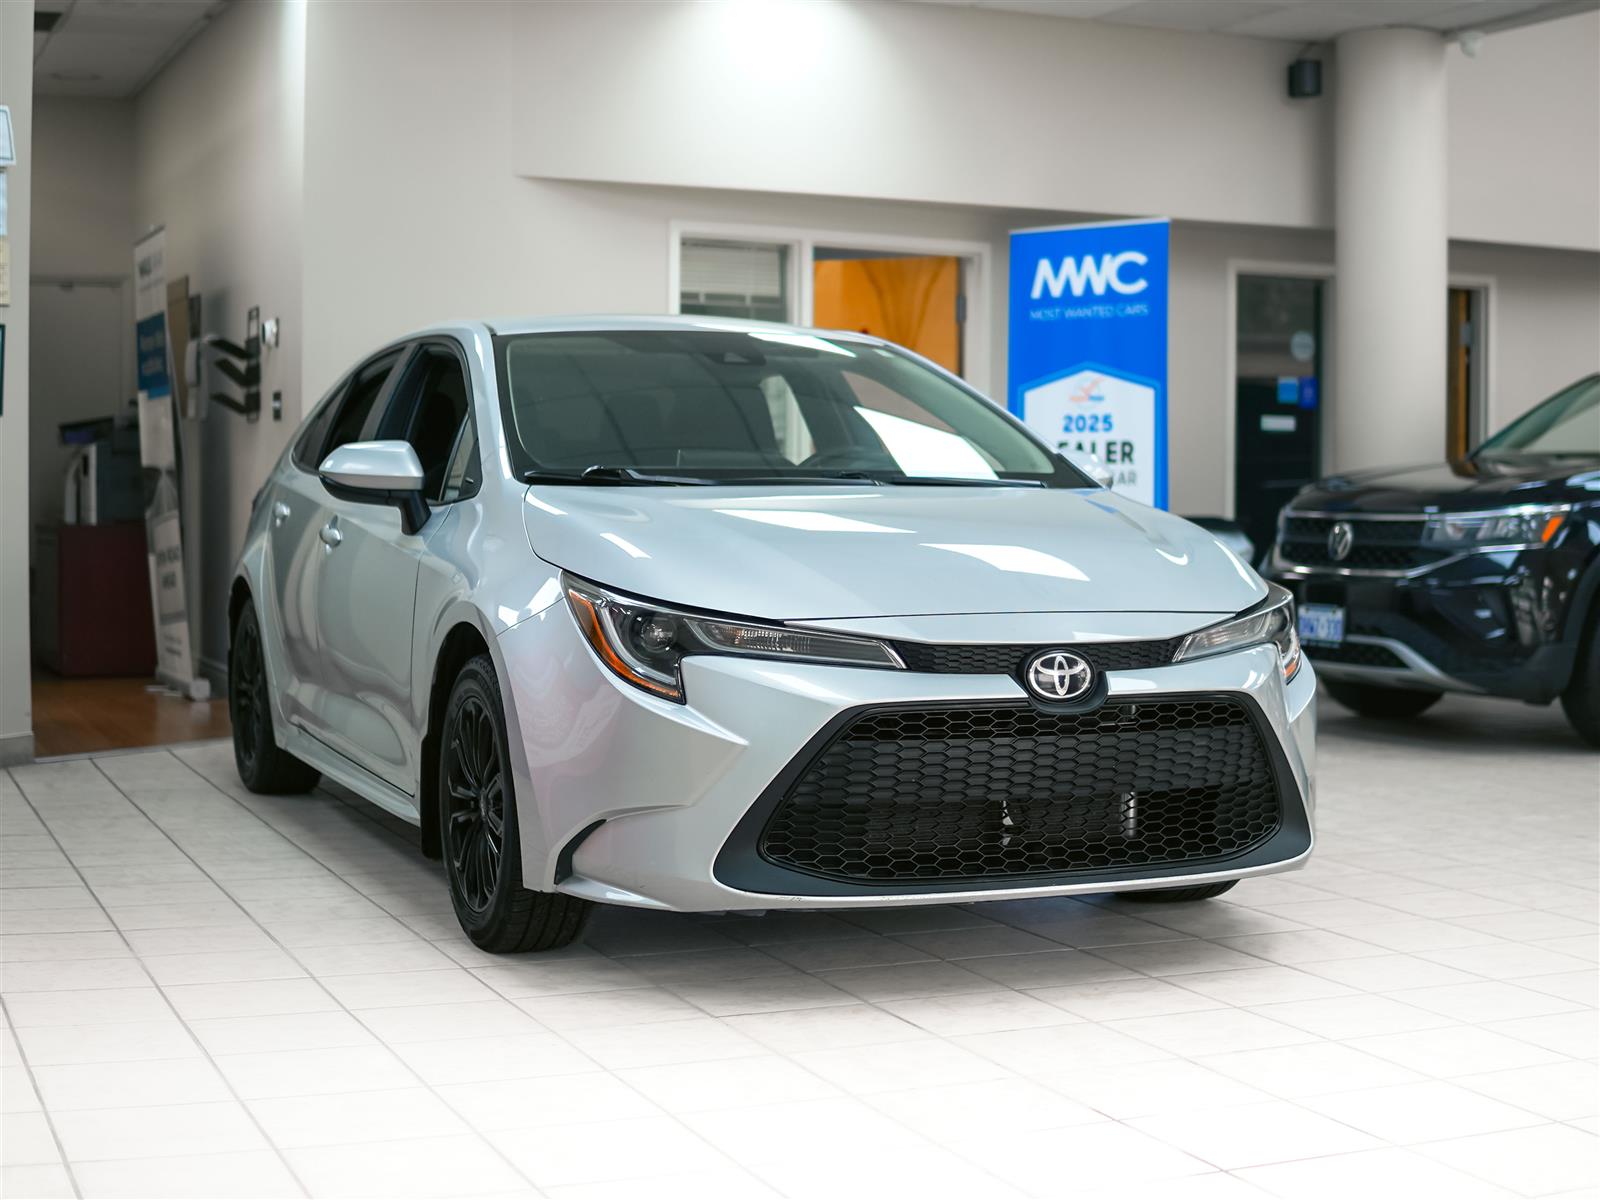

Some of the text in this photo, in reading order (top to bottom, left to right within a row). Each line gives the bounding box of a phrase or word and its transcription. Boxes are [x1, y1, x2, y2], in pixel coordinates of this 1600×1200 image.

[1030, 251, 1148, 299] MWC
[1030, 302, 1148, 319] MOST WANTED CARS
[1062, 413, 1113, 433] 2025
[1057, 441, 1135, 464] ALER
